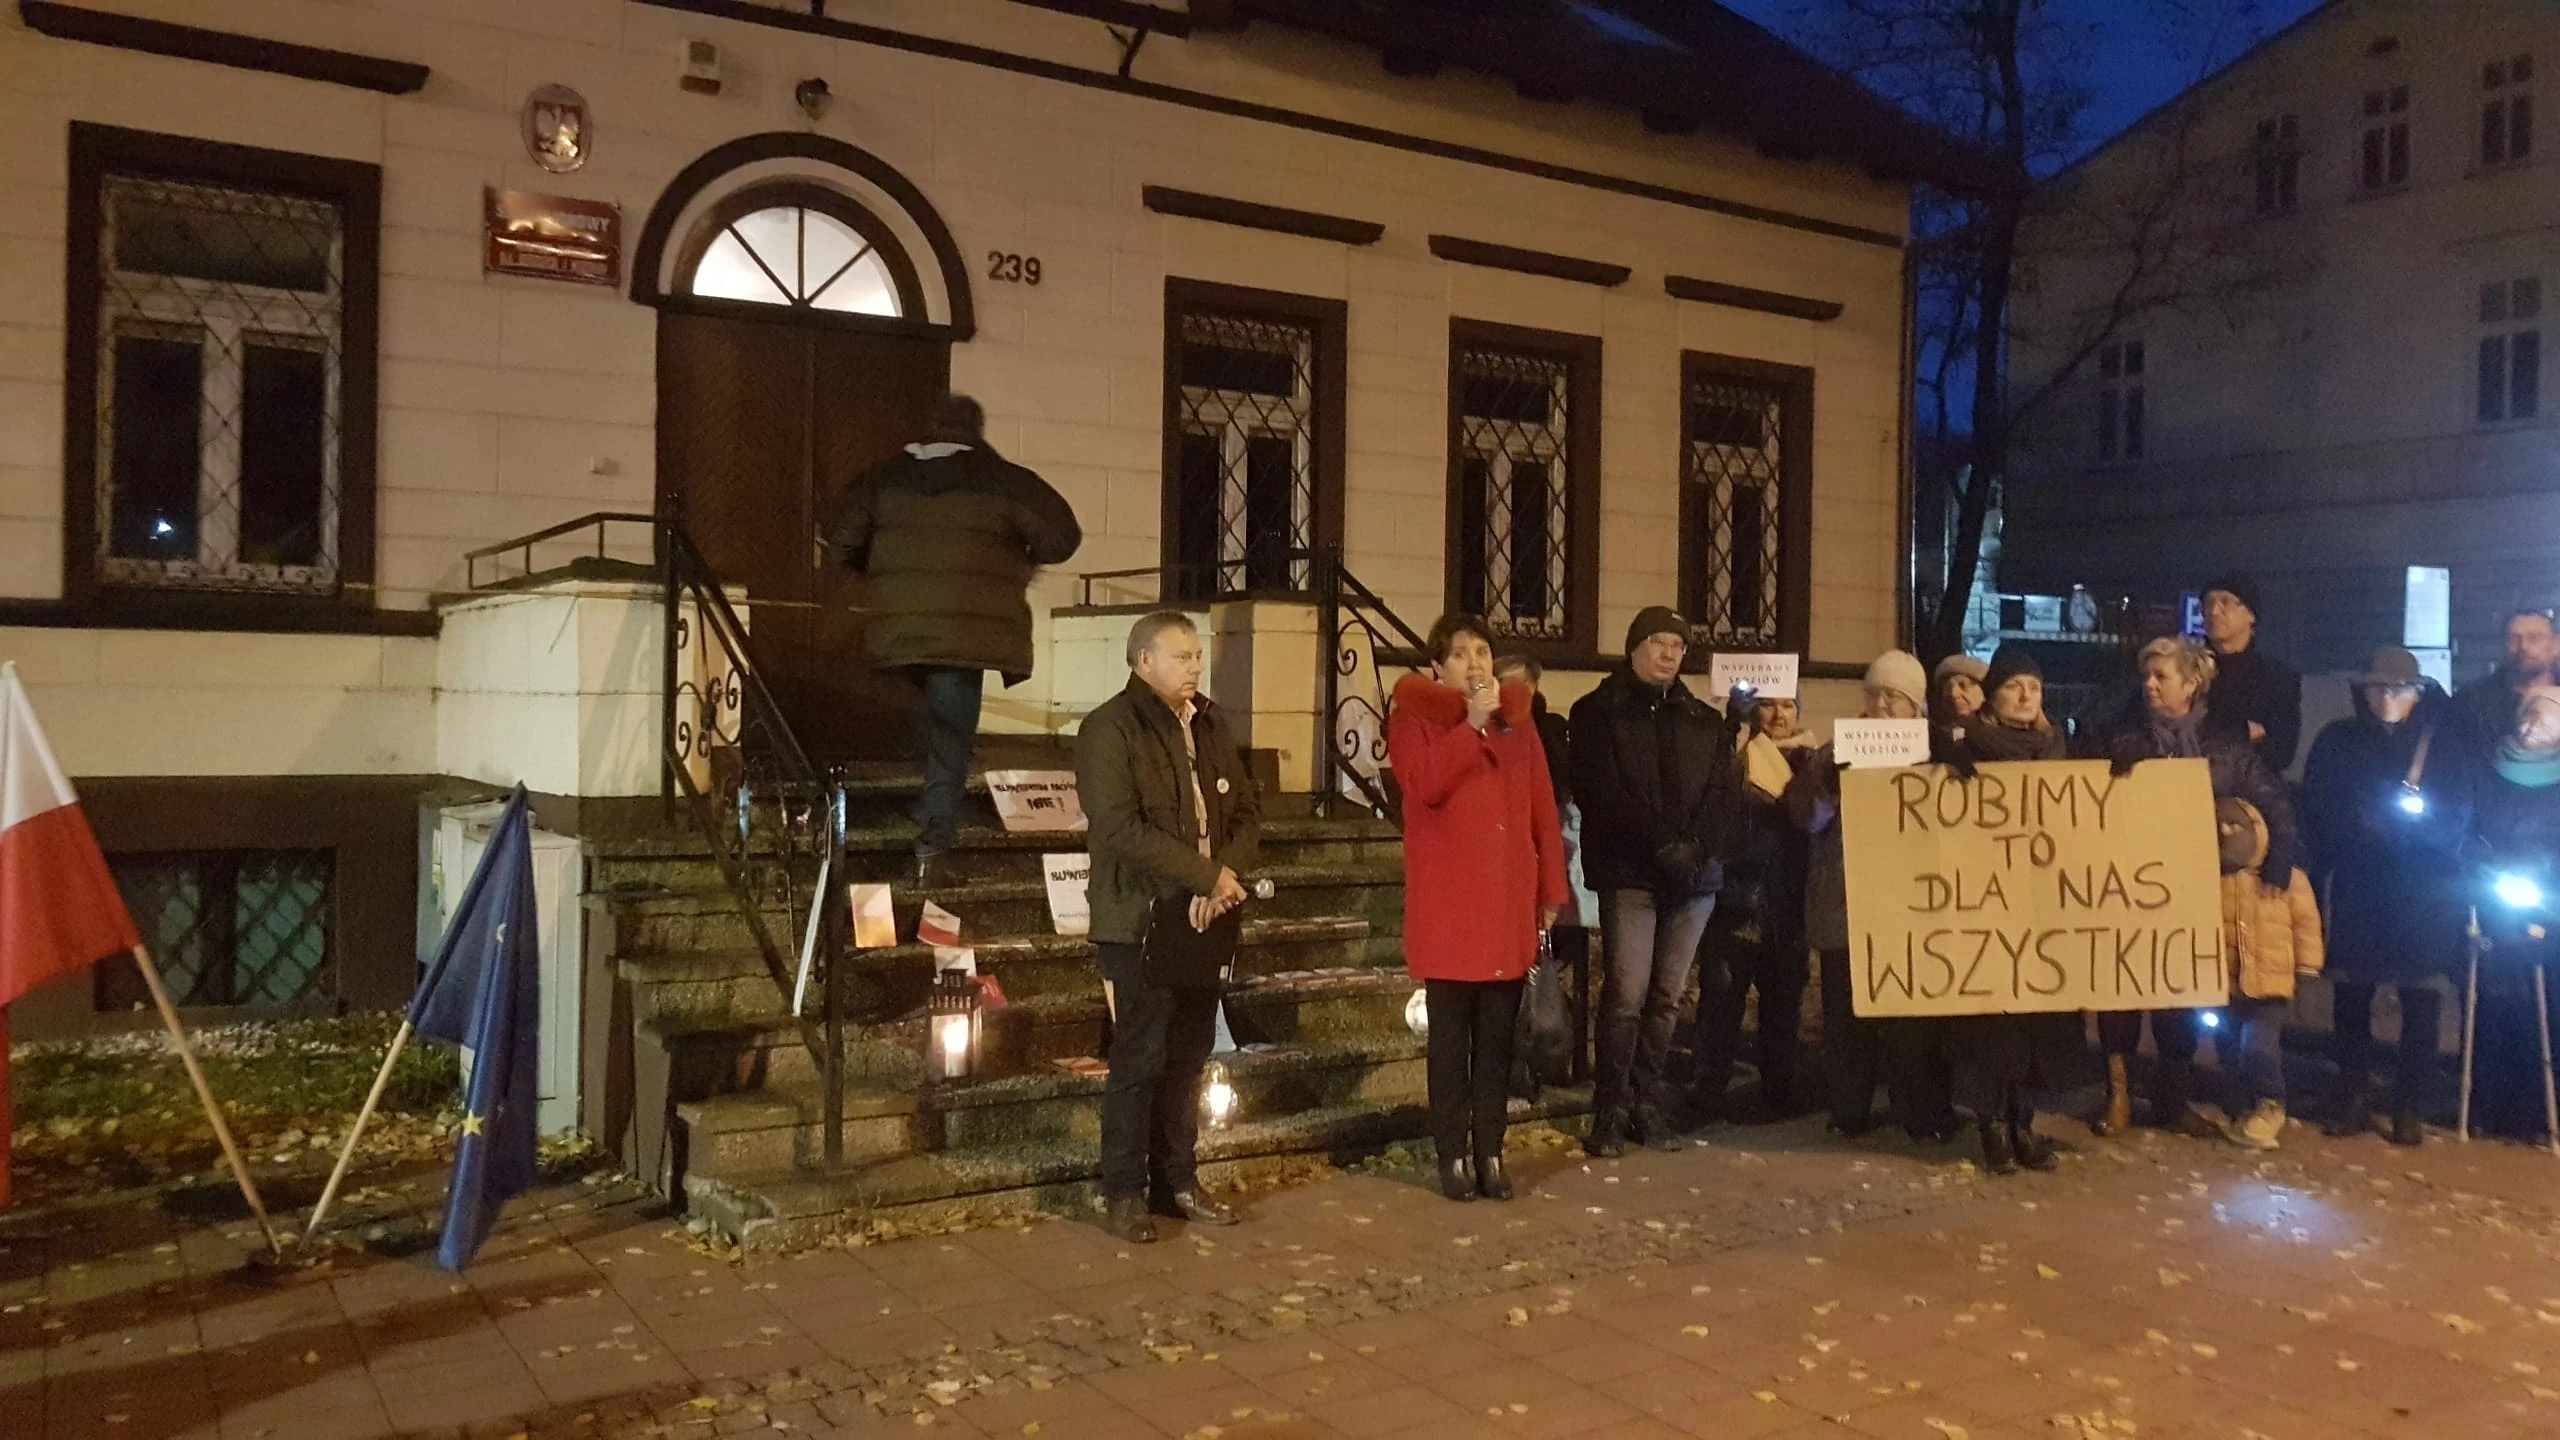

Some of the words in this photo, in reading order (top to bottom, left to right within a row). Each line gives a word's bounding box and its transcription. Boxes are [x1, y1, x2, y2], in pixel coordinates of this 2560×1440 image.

[987, 250, 1041, 287] 239
[1890, 771, 2117, 832] ROBIMY
[1993, 830, 2056, 871] TO
[1907, 868, 2009, 912] DLA
[2058, 861, 2171, 911] NAS
[1866, 926, 2223, 1004] WSZYSTKICH
